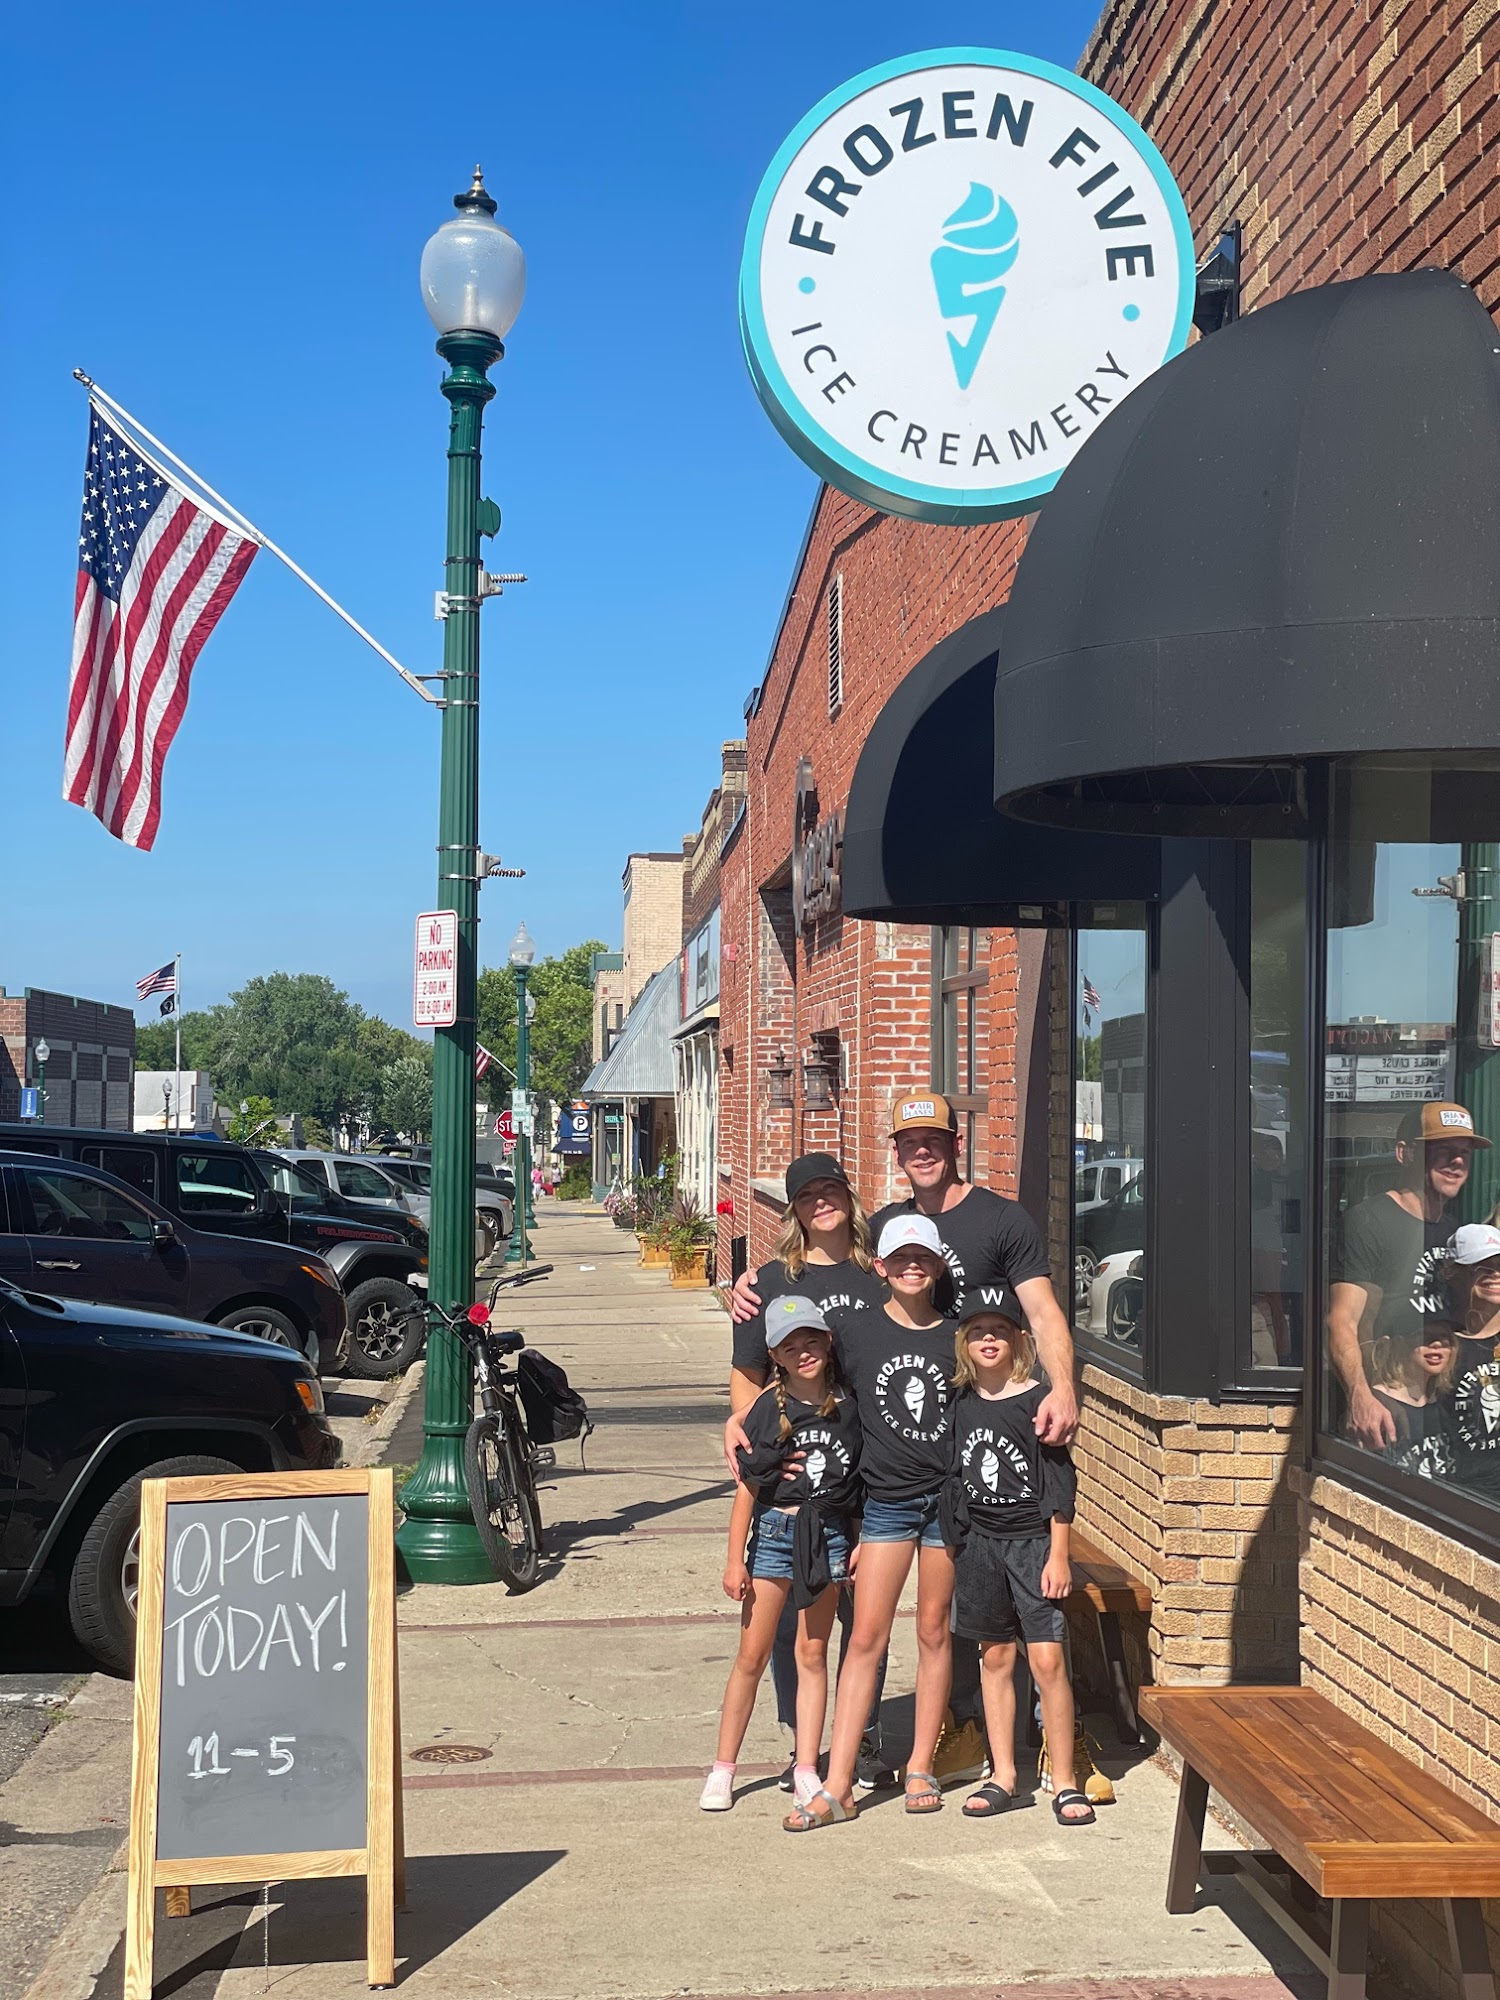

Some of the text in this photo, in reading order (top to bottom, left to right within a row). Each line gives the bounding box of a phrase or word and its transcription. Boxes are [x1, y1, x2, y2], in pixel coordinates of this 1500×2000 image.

[789, 90, 1155, 280] FROZEN FIVE
[792, 322, 1130, 467] ICE CREAMERY
[430, 924, 442, 945] NO
[418, 949, 453, 971] PARKING
[438, 980, 447, 994] AM
[442, 999, 452, 1013] AM
[904, 1110, 933, 1118] PLANES
[499, 1120, 511, 1131] ST
[317, 1226, 395, 1242] RUBICON
[980, 1288, 1004, 1306] W
[875, 1354, 947, 1404] FROZEN FIVE
[881, 1410, 900, 1429] ICE
[996, 1435, 1029, 1473] FIVE
[963, 1479, 979, 1499] ICE
[172, 1509, 340, 1597] OPEN
[163, 1588, 348, 1687] TODAY!
